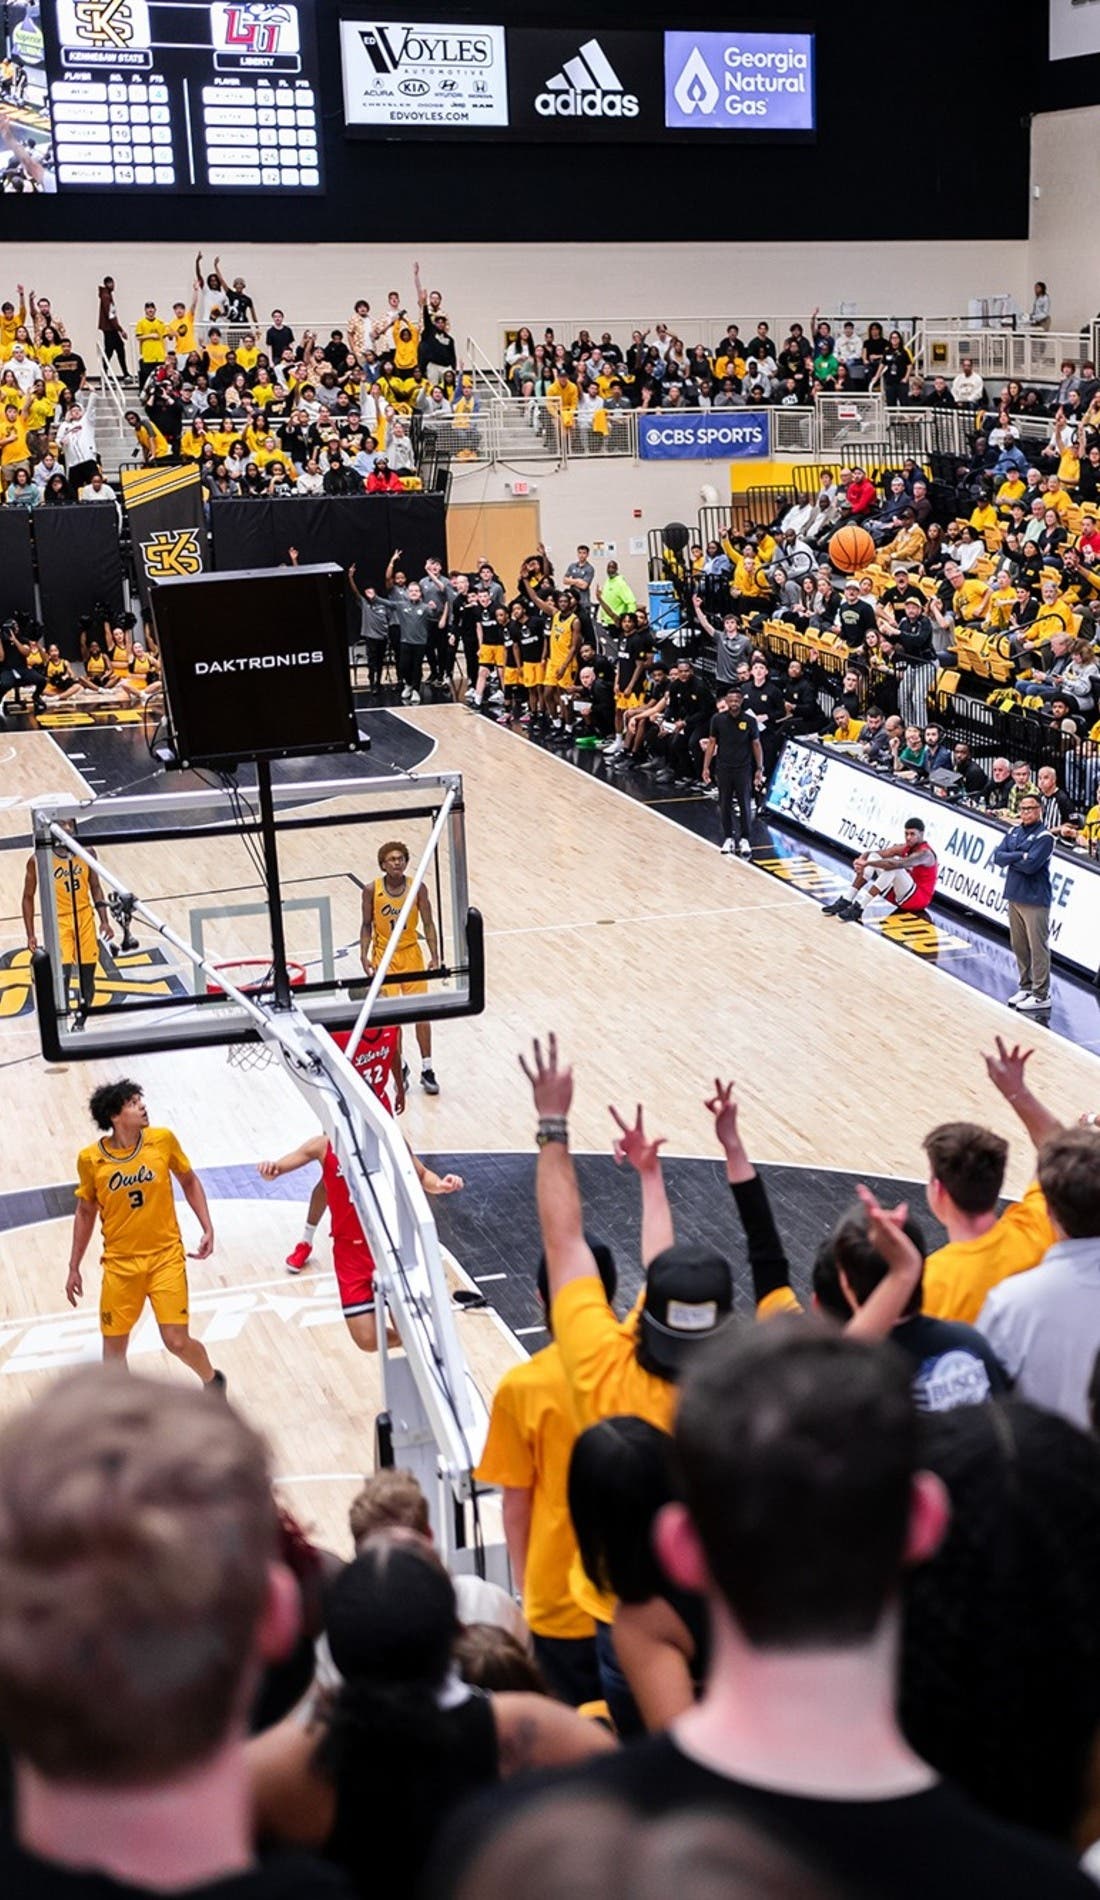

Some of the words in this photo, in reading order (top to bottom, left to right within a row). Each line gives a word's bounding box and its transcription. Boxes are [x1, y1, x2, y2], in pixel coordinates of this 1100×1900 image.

[364, 37, 376, 45] ED
[375, 26, 488, 70] VOYLES
[240, 56, 275, 66] LIBERTY
[724, 46, 807, 73] Georgia
[403, 83, 425, 92] KIA
[725, 71, 806, 92] Natural
[535, 88, 640, 117] adidas
[725, 95, 767, 115] Gas
[389, 111, 469, 121] EDVOYLES.COM
[661, 429, 695, 445] CBS
[697, 427, 763, 444] SPORTS
[195, 651, 324, 675] DAKTRONICS
[944, 828, 985, 864] AND
[355, 1046, 389, 1067] Liberty
[363, 1065, 383, 1084] 32
[109, 1165, 153, 1191] Owls
[128, 1190, 143, 1209] 3
